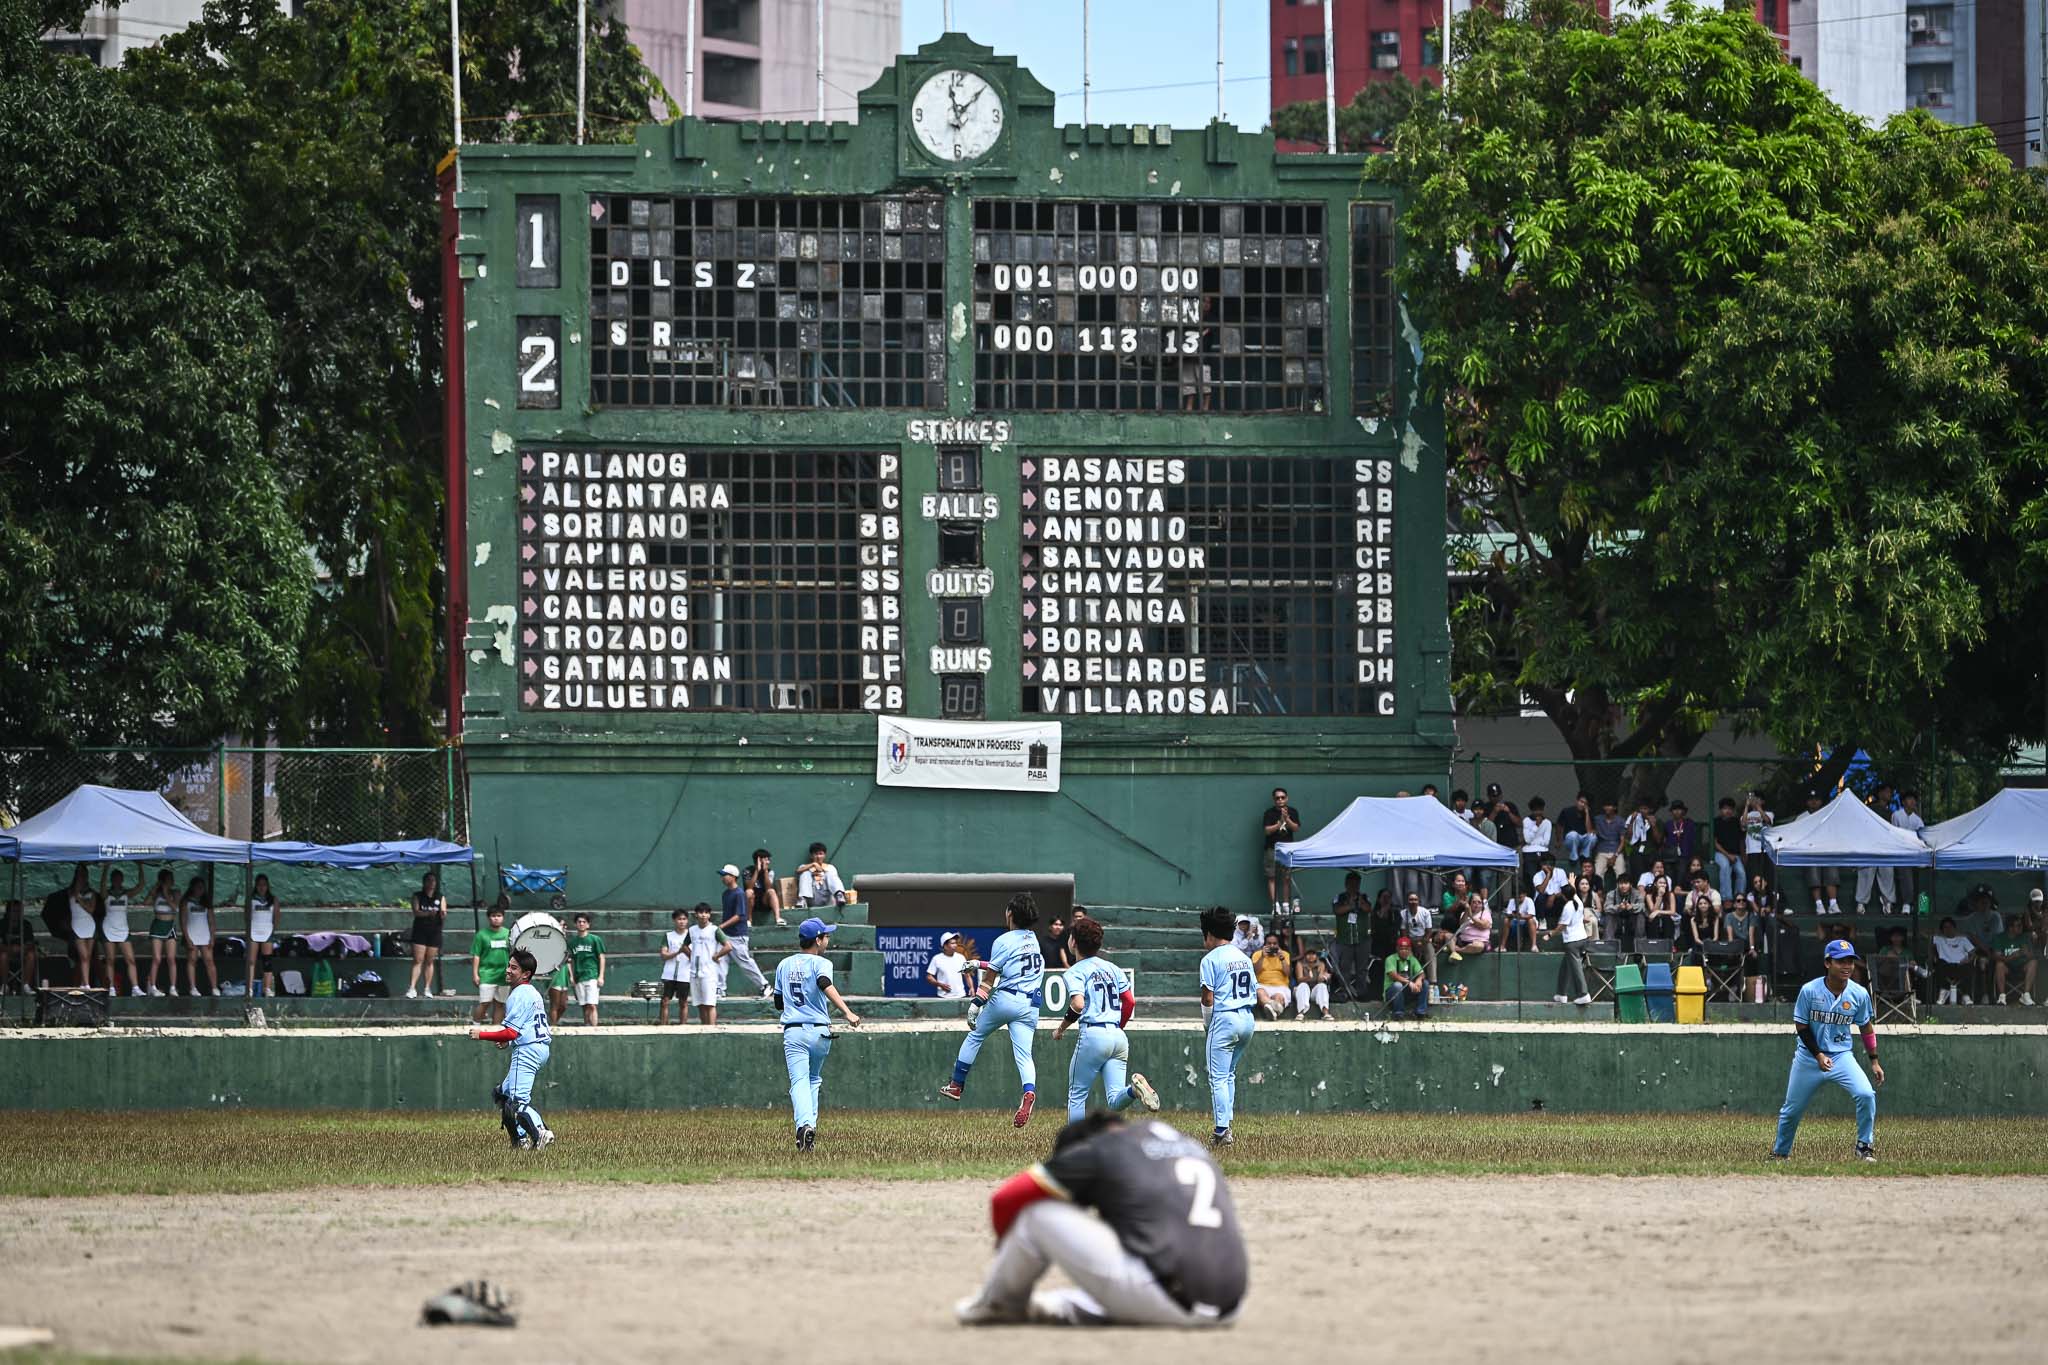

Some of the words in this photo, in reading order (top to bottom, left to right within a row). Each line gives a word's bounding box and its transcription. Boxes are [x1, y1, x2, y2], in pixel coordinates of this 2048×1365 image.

[952, 72, 963, 87] 12
[915, 108, 923, 122] 9
[993, 109, 1000, 123] 3
[954, 144, 961, 158] 6
[530, 214, 546, 268] 1
[995, 265, 1051, 291] 001
[1079, 266, 1137, 291] 000
[1161, 268, 1198, 292] 00
[995, 326, 1052, 351] 000
[1079, 327, 1137, 352] 113
[1166, 331, 1199, 353] 13
[519, 337, 555, 391] 2
[910, 420, 1009, 441] STRIKES
[543, 453, 686, 478] PALANOG
[880, 455, 897, 479] P
[1356, 460, 1391, 483] SS
[543, 483, 729, 508] ALCANTARA
[882, 485, 899, 509] C
[922, 497, 997, 518] BALLS
[1045, 487, 1164, 512] GENOTA
[1357, 488, 1392, 512] 1B
[543, 513, 687, 538] SORIANO
[861, 514, 899, 540] 3B
[1043, 517, 1185, 542] ANTONIO
[1357, 519, 1391, 542] RF
[544, 543, 646, 565] TAPIA
[861, 545, 897, 566] CF
[1043, 547, 1204, 568] SALVADOR
[1357, 548, 1390, 569] CF
[544, 569, 687, 591] VALERUS
[862, 570, 899, 591] SS
[931, 573, 991, 594] OUTS
[1042, 572, 1163, 593] CHAVEZ
[1357, 573, 1392, 594] 2B
[544, 596, 687, 620] CALANOG
[862, 596, 899, 620] 1B
[1042, 598, 1185, 623] BITANGA
[1357, 598, 1392, 623] 3B
[544, 626, 687, 650] TROZADO
[862, 626, 899, 650] RF
[1043, 628, 1143, 653] BORJA
[1358, 629, 1392, 653] LF
[544, 655, 730, 681] GATMAITAN
[863, 655, 900, 680] LF
[932, 649, 991, 670] RUNS
[1042, 658, 1206, 682] ABELARDE
[1359, 659, 1393, 682] DH
[544, 684, 689, 708] ZULUETA
[864, 685, 902, 709] 2B
[1043, 688, 1228, 714] VILLAROSA
[1379, 692, 1394, 714] C
[977, 739, 985, 750] IN
[1027, 770, 1048, 779] PABA
[879, 936, 932, 950] PHILIPPINE
[884, 951, 928, 965] WOMEN'S
[893, 966, 919, 979] OPEN
[790, 982, 805, 1008] 5
[1230, 971, 1251, 999] 19
[1094, 983, 1121, 1013] 76
[1174, 1157, 1222, 1228] 2
